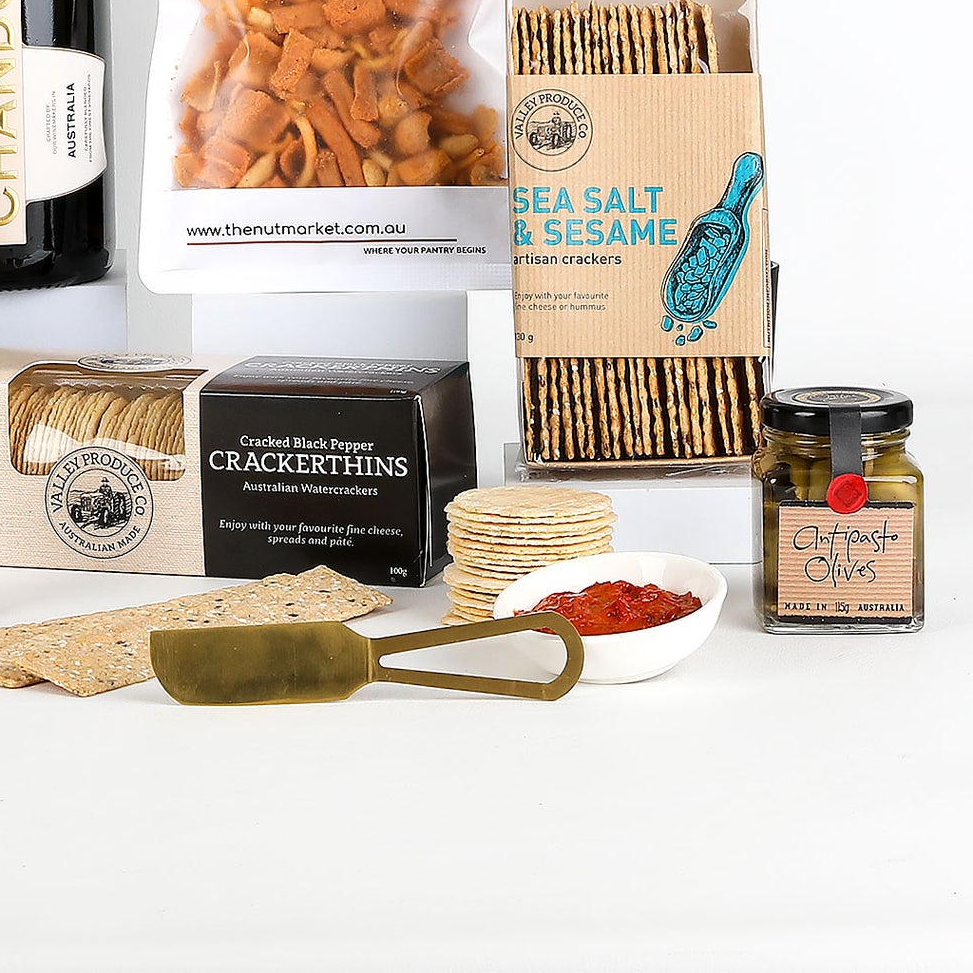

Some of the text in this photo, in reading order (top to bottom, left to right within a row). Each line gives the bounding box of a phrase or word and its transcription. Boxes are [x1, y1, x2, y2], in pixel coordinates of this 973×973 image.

[66, 82, 77, 159] AUSTRALIA
[514, 96, 538, 140] VALLEY
[538, 92, 587, 122] PRODUCE
[513, 186, 664, 214] SEA SALT
[186, 222, 407, 238] www.thenutmarket.com.au
[513, 219, 678, 246] & SESAME
[363, 245, 487, 256] WHERE YOUR PANTRY BEGINS
[513, 252, 623, 265] artisan crackers
[535, 291, 552, 300] with
[553, 293, 571, 302] your
[573, 292, 609, 300] favourite
[528, 303, 557, 311] cheese
[570, 303, 606, 311] hummus
[527, 334, 534, 344] g
[240, 435, 374, 454] Cracked Black Pepper
[208, 450, 409, 478] CRACKERTHINS
[50, 456, 81, 513] VALLEY
[81, 452, 144, 494] PRODUCE
[242, 481, 379, 496] Australian Watercrackers
[58, 522, 141, 552] AUSTRALIAN MADE
[219, 519, 404, 538] Enjoy with your favourite fine cheese,
[267, 535, 354, 548] spreads and pâté.
[390, 567, 408, 577] 100g
[804, 553, 877, 588] Olives
[784, 602, 811, 611] MADE
[816, 602, 827, 611] IN
[857, 603, 905, 612] AUSTRALIA
